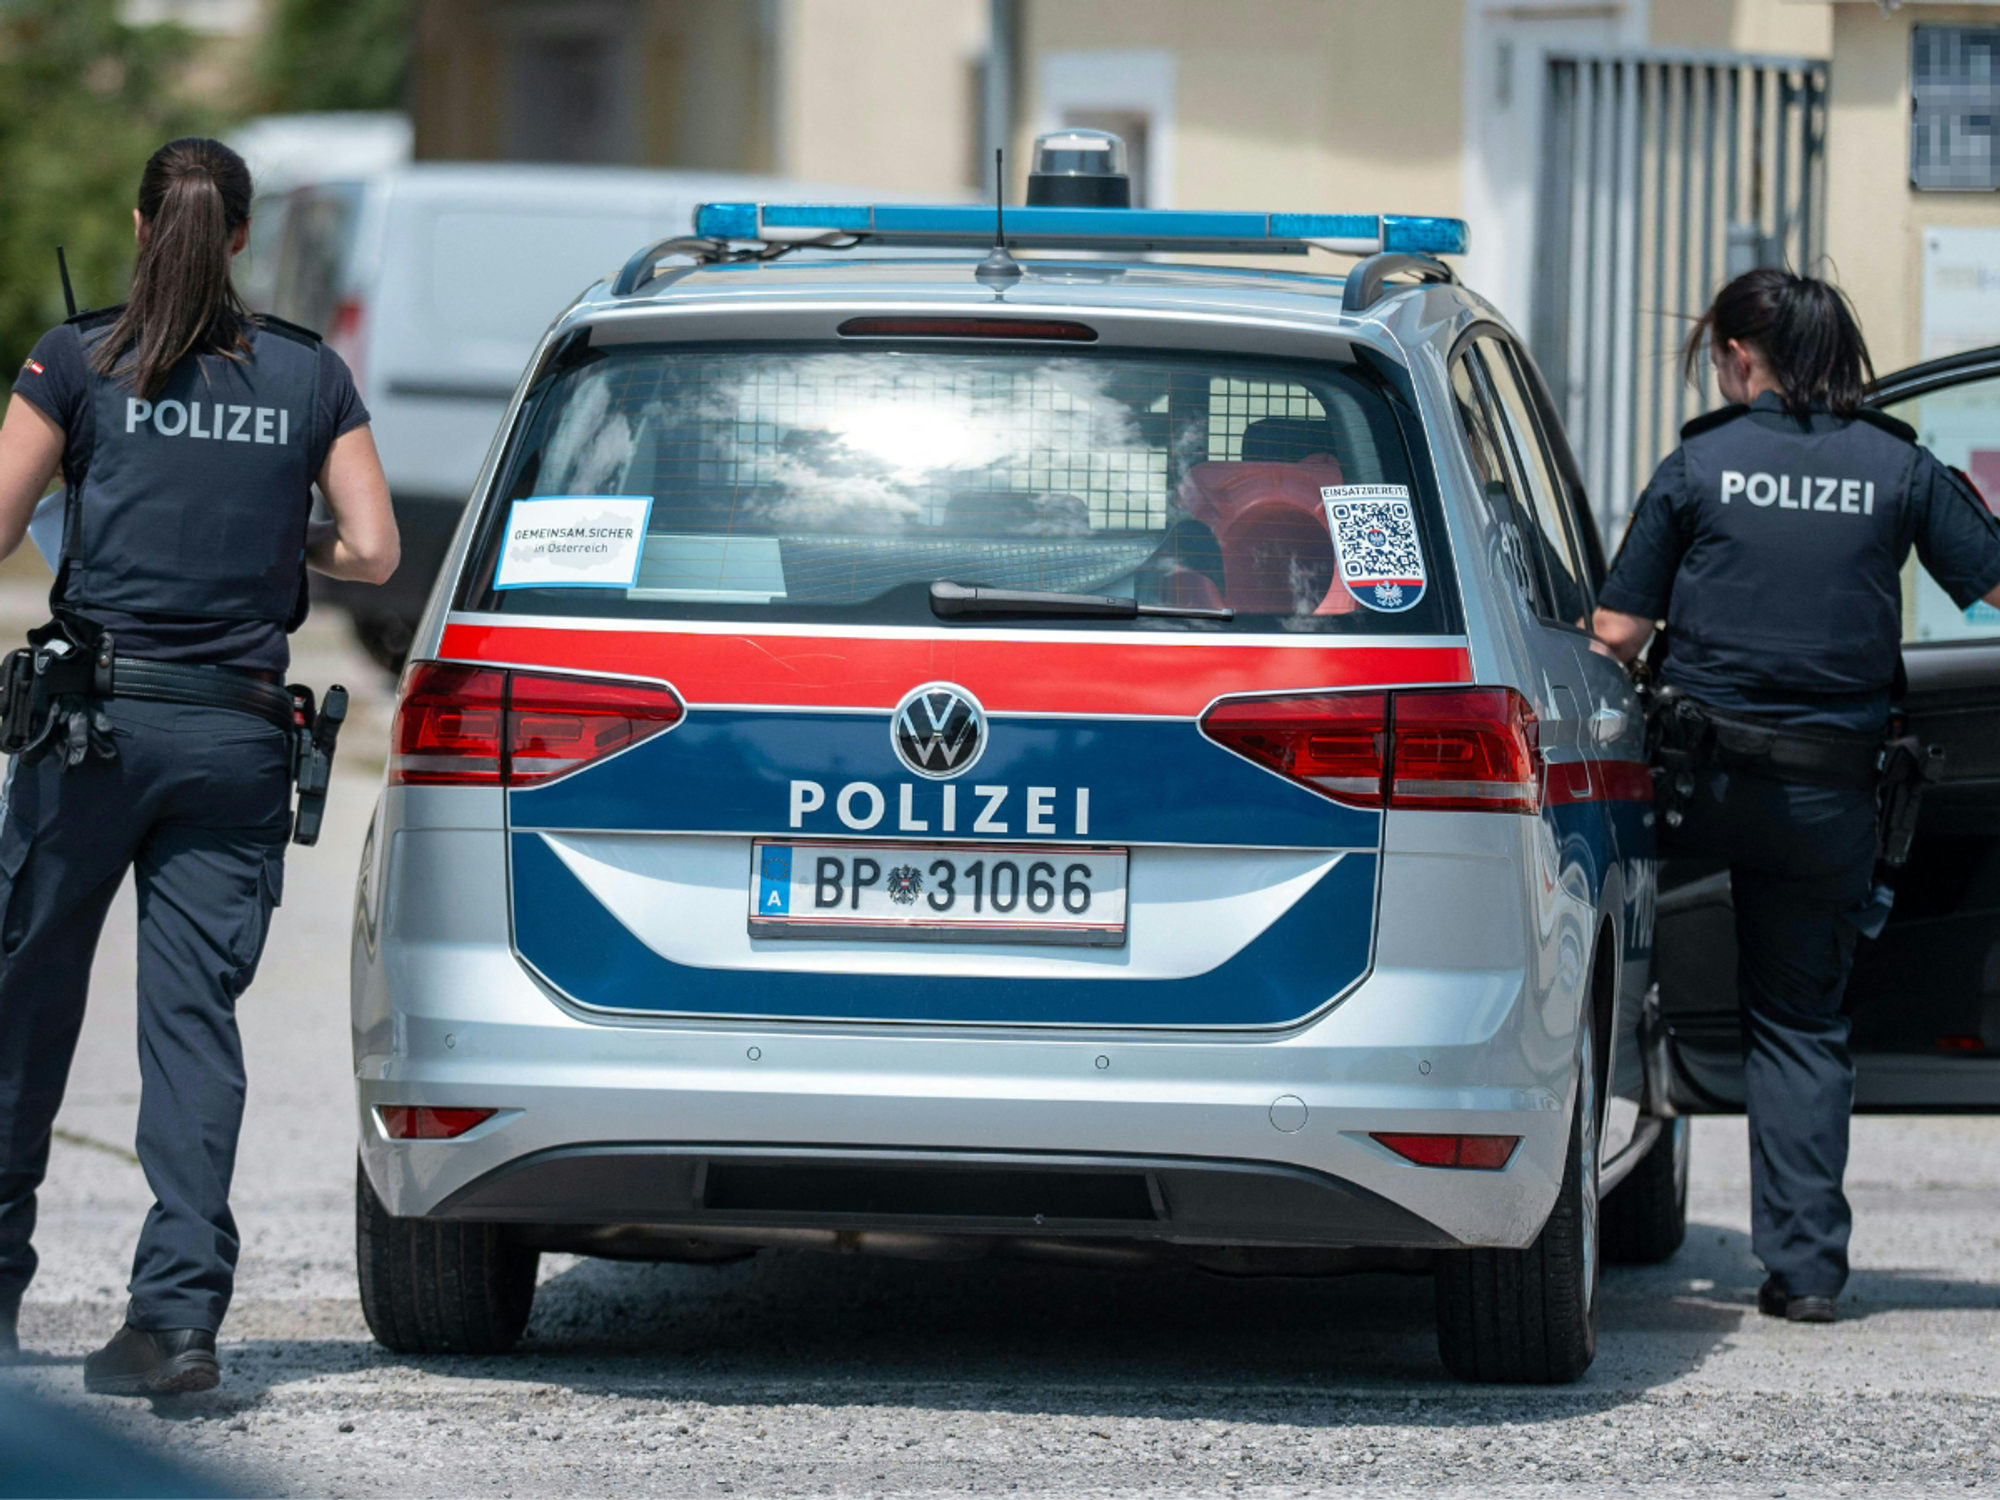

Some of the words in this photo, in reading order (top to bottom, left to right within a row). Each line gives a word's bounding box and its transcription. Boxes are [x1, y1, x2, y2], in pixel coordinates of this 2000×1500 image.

[126, 397, 289, 445] POLIZEI
[1720, 470, 1875, 515] POLIZEI
[514, 527, 634, 540] GEMEINSAM.SICHER
[533, 543, 545, 553] in
[547, 540, 608, 553] Österreich
[789, 779, 1091, 835] POLIZEI
[766, 890, 782, 907] A
[815, 856, 881, 910] BP
[926, 859, 1092, 915] 31066
